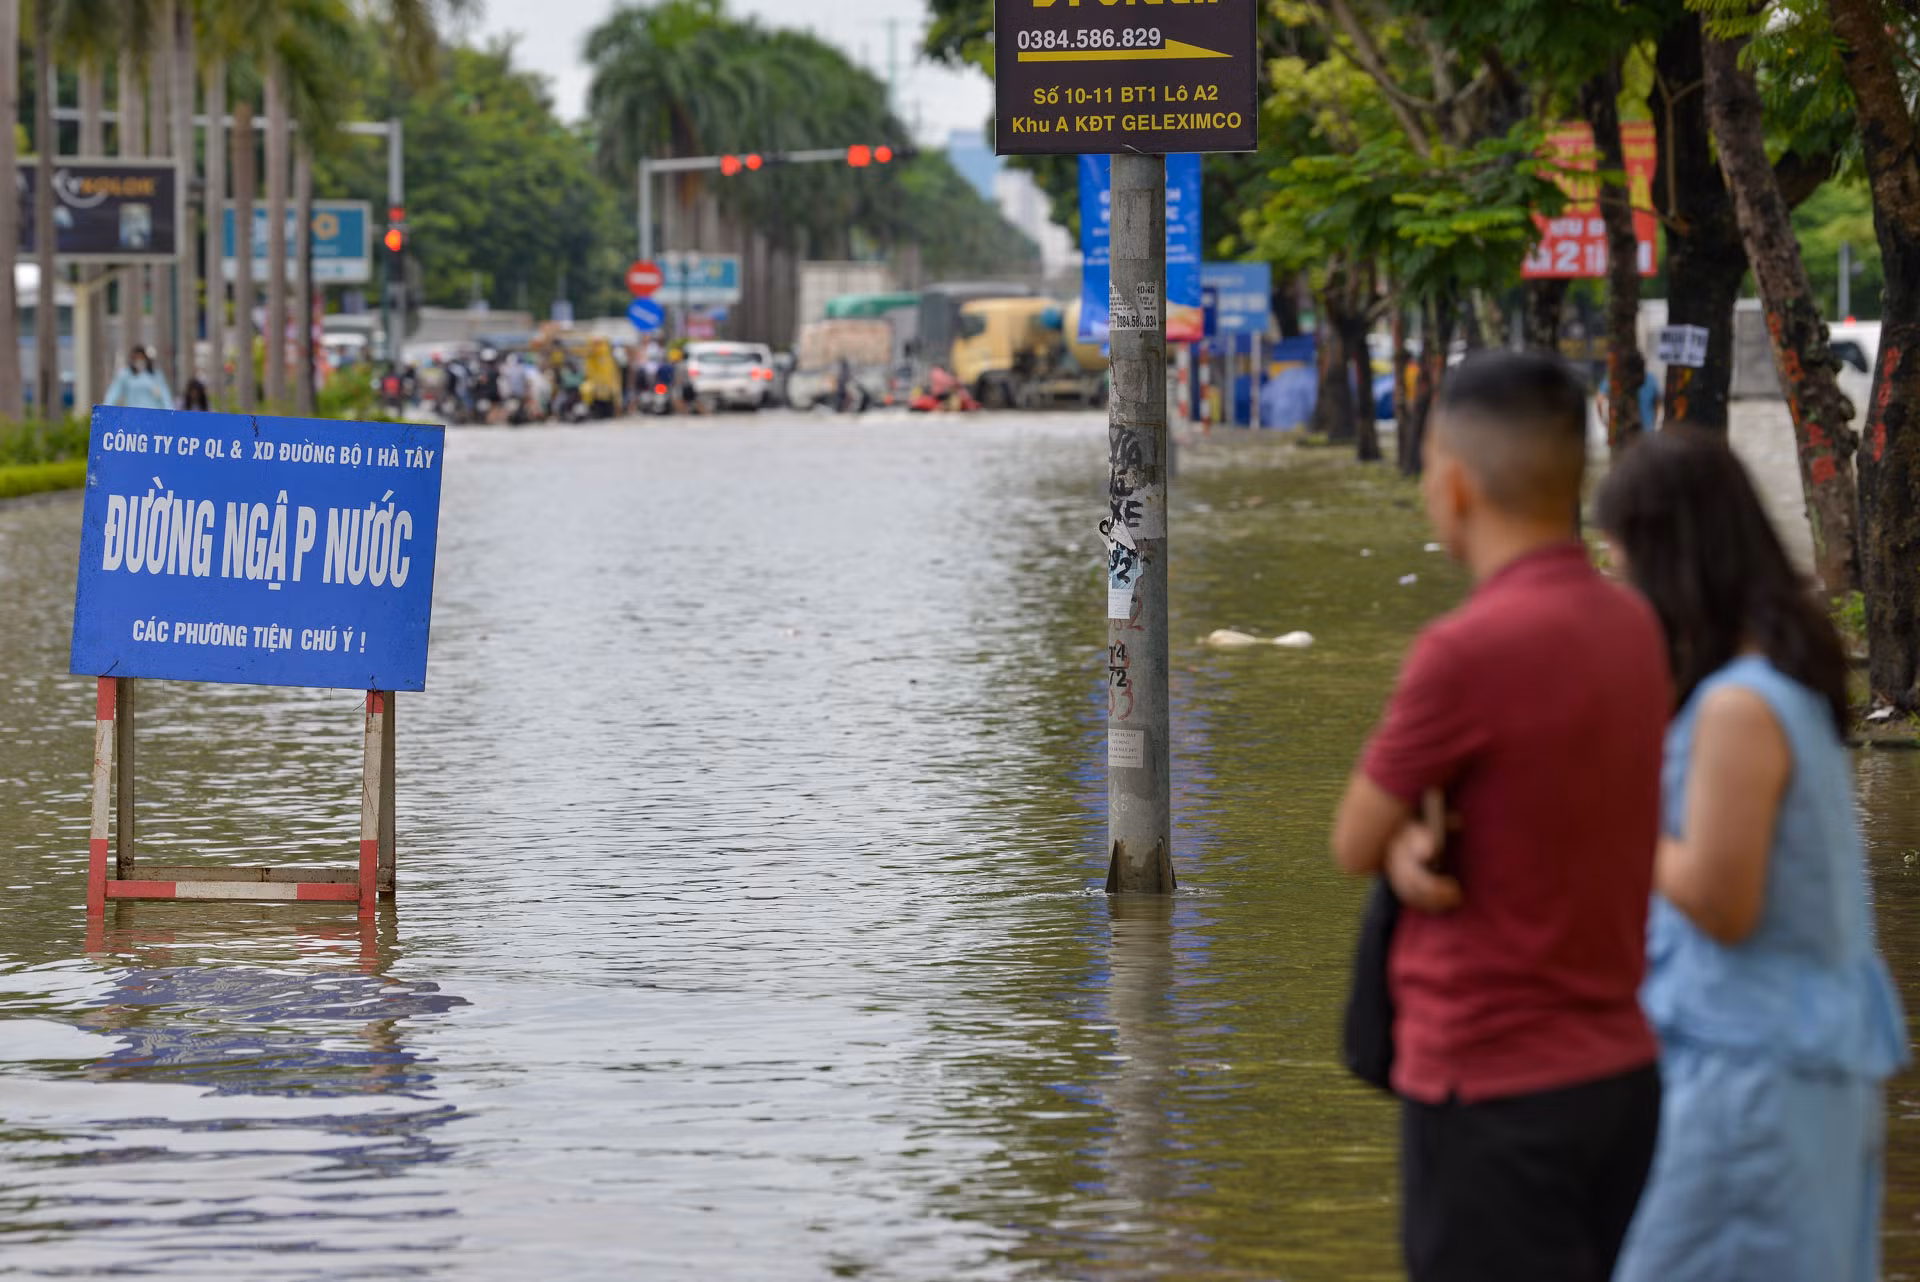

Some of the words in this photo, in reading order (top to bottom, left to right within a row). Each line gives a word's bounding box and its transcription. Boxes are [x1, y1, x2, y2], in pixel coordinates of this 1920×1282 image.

[1017, 27, 1161, 49] 0384.586.829
[1033, 85, 1060, 105] Số
[1065, 87, 1112, 104] 10-11
[1121, 86, 1156, 103] BT1
[1164, 84, 1189, 102] Lô
[1193, 84, 1218, 101] A2
[1012, 116, 1050, 133] Khu
[1055, 115, 1069, 132] A
[1075, 115, 1116, 132] KĐT
[1121, 112, 1242, 131] GELEXIMCO
[103, 428, 148, 453] CÔNG
[153, 435, 173, 454] TY
[177, 436, 200, 456] CP
[205, 438, 225, 459] QL
[230, 440, 242, 459] &
[252, 441, 275, 460] XD
[340, 443, 362, 469] BỘ
[378, 444, 399, 467] HÀ
[405, 446, 435, 469] TÂY
[102, 476, 215, 578] ĐƯỜNG
[322, 490, 413, 588] NƯỚC
[132, 616, 169, 643] CÁC
[173, 621, 248, 647] PHƯƠNG
[253, 623, 293, 653] TIỆN
[300, 625, 338, 652] CHÚ
[343, 626, 354, 652] Ý
